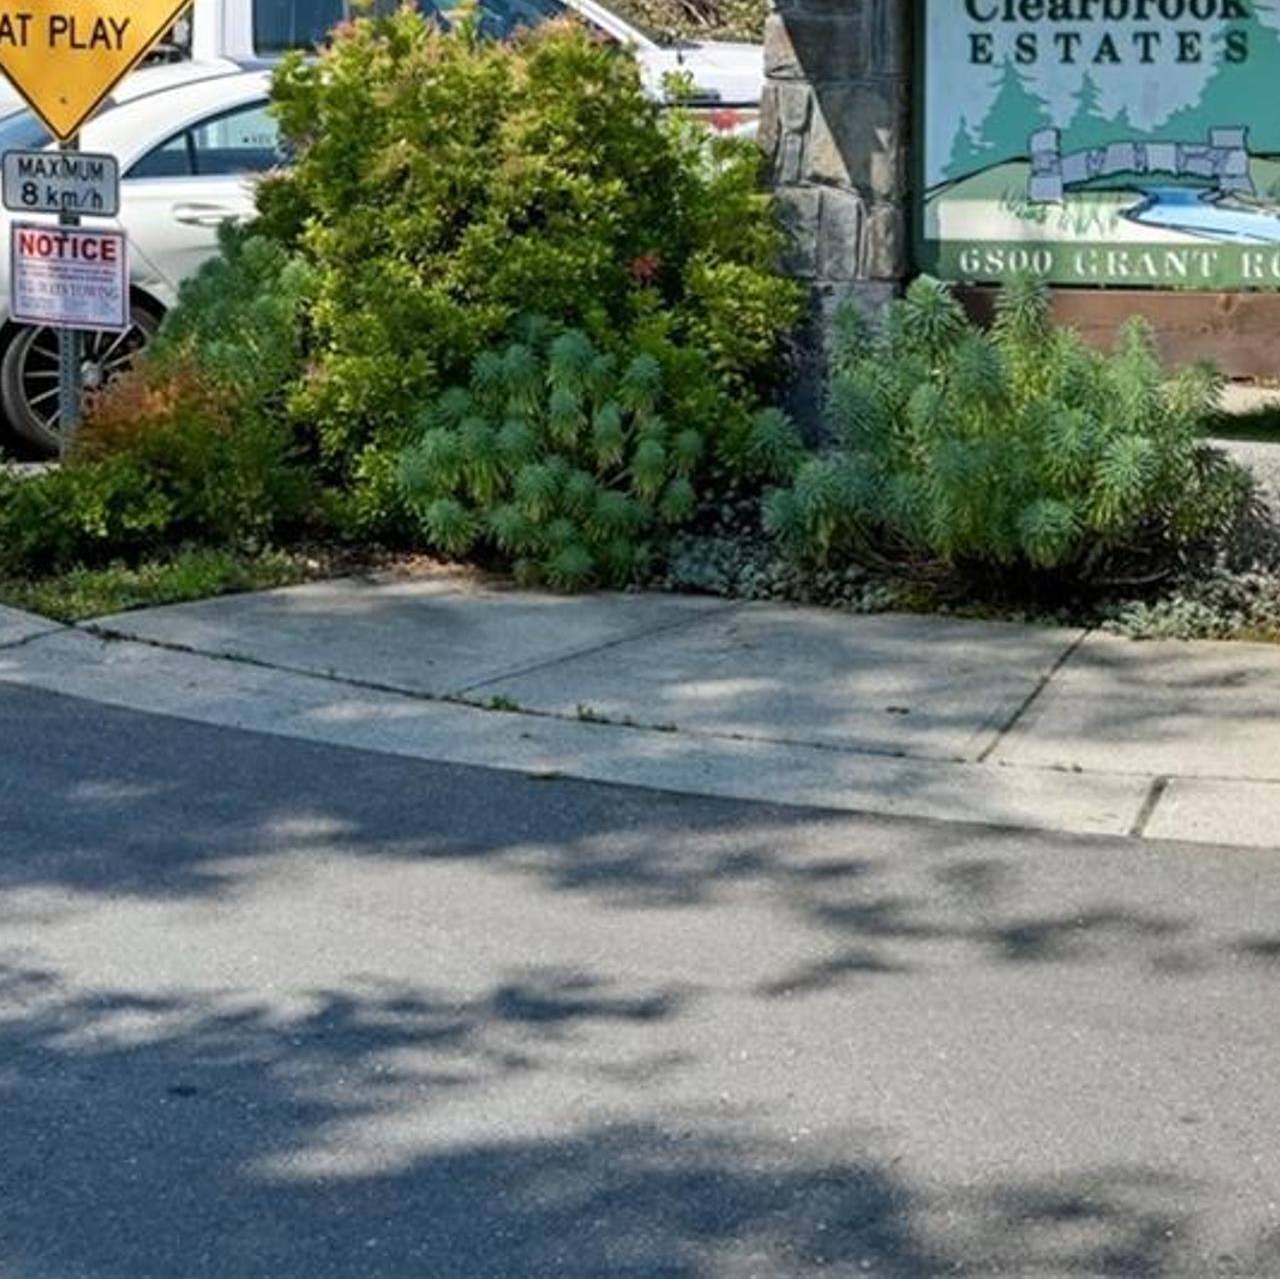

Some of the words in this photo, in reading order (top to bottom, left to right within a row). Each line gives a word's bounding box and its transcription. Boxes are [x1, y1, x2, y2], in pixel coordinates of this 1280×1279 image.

[48, 15, 131, 51] PLAY
[969, 30, 1251, 66] ESTATES
[18, 156, 105, 183] MAXIMUM
[21, 182, 39, 205] 8
[46, 187, 104, 210] km/h
[19, 234, 116, 261] NOTICE
[960, 249, 1055, 277] 6800
[1075, 249, 1219, 278] GRANT
